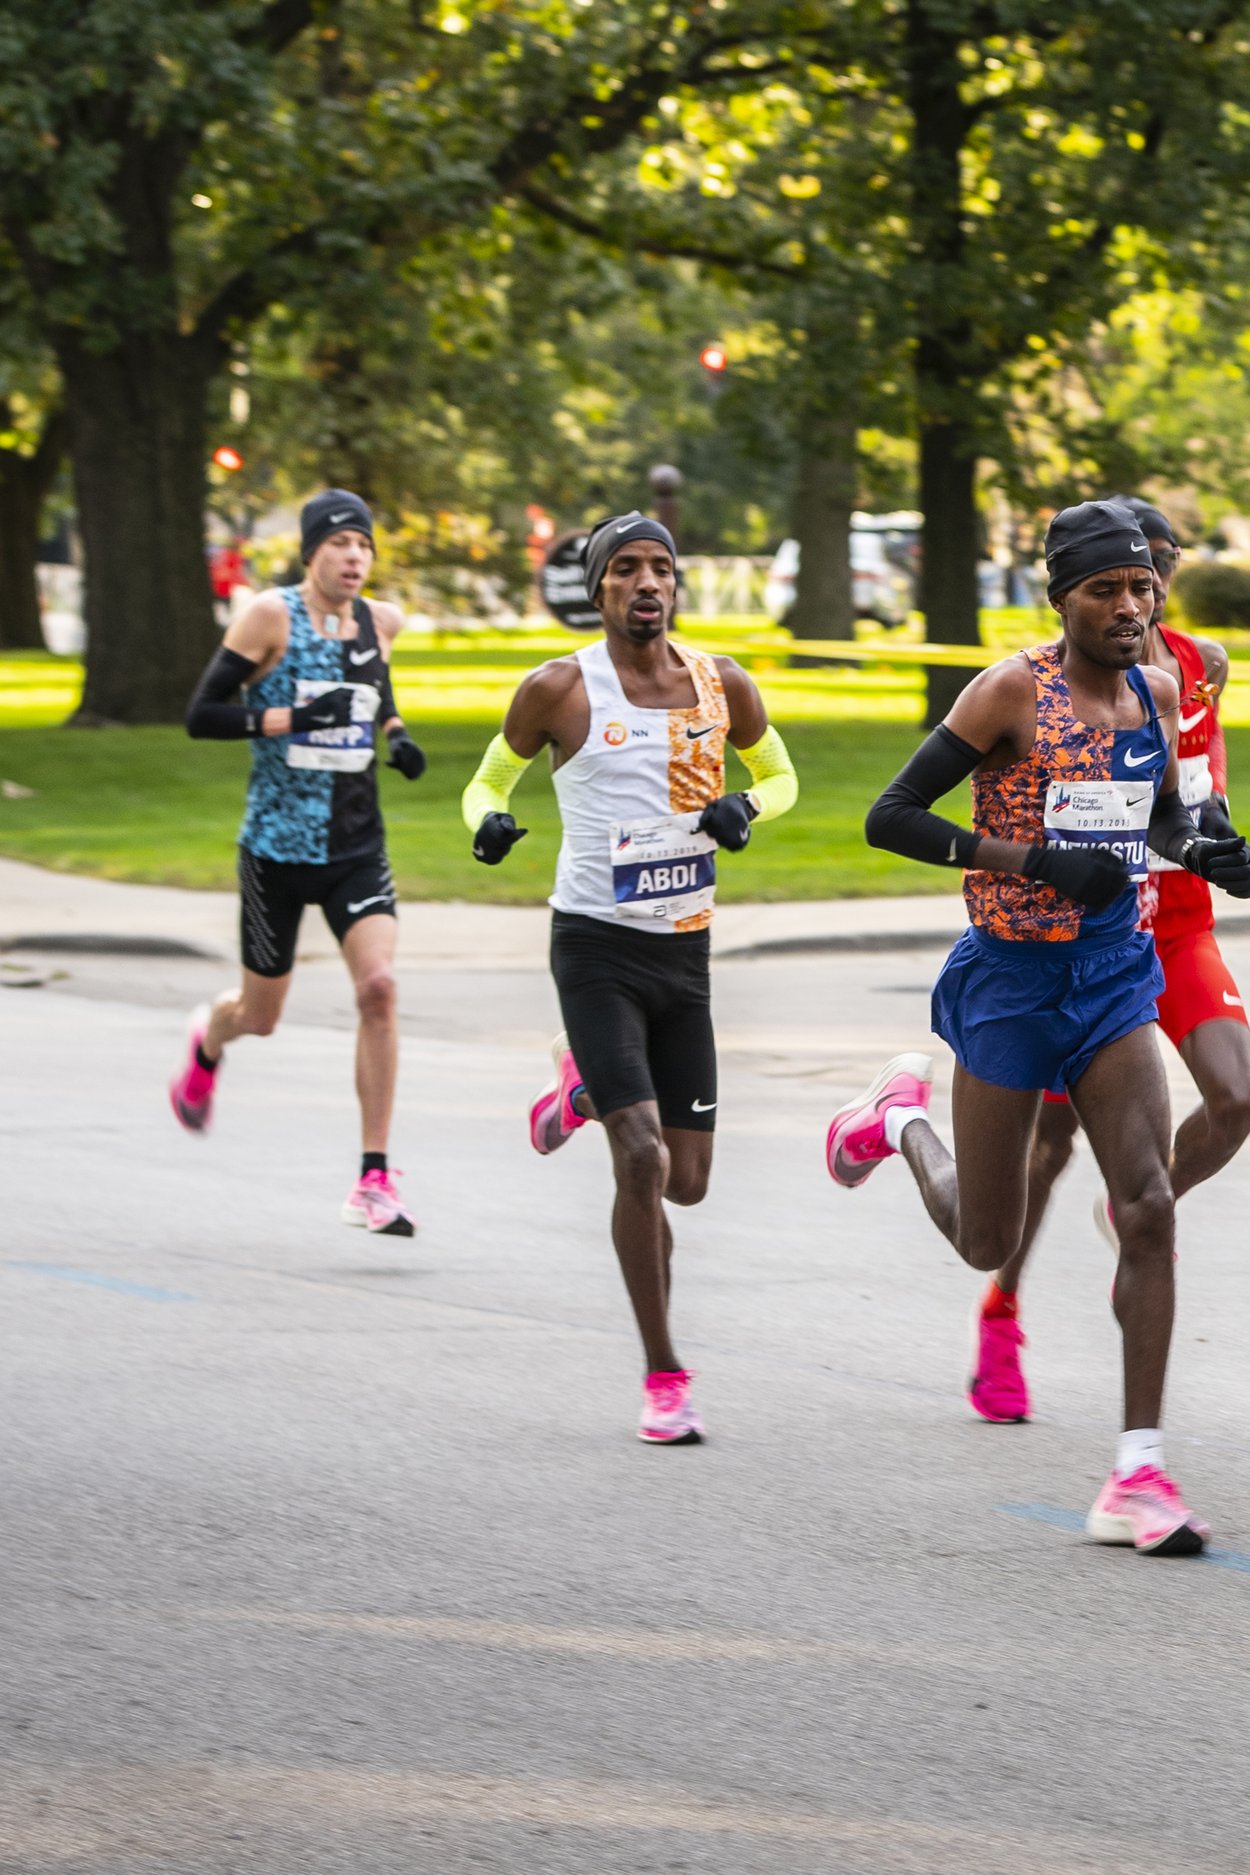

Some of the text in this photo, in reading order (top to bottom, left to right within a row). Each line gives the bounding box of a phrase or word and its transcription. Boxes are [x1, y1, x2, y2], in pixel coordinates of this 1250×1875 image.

[631, 729, 649, 737] NN
[1072, 796, 1099, 806] Chicago
[636, 863, 698, 894] ABDI
